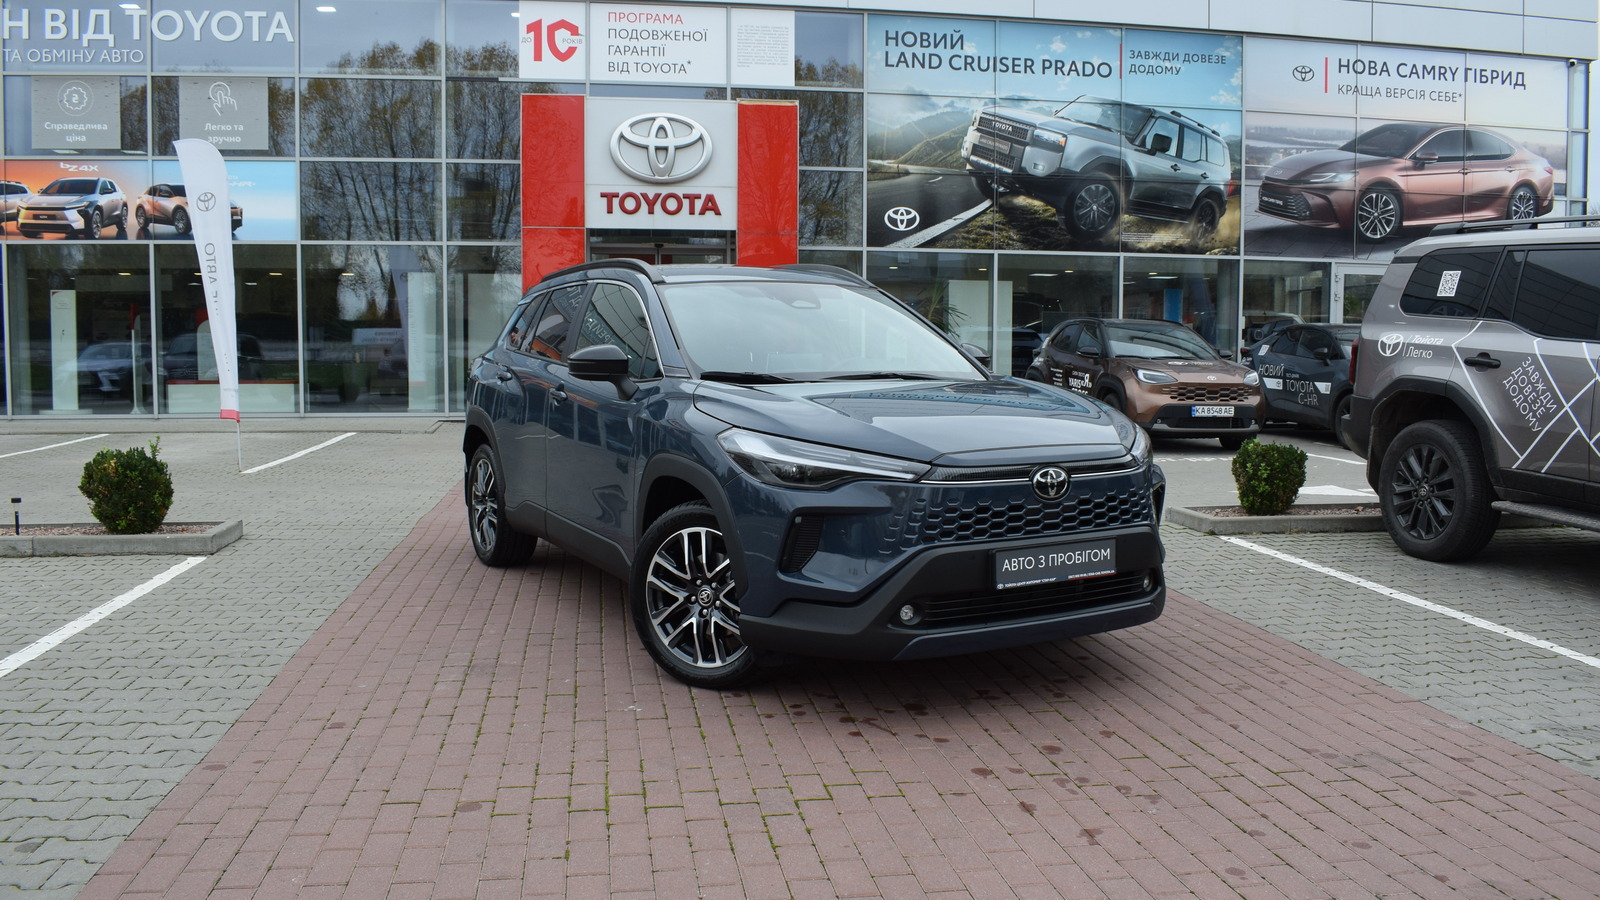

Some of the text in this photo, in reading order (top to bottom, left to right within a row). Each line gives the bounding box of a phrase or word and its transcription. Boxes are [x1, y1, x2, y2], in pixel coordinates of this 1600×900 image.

[607, 11, 684, 25] ПРОГРАМА
[44, 8, 115, 48] ВІД
[125, 9, 295, 43] TOYOTA
[607, 28, 709, 42] ПОДОВЖЕНОЇ
[561, 37, 583, 45] РОКІВ
[884, 29, 964, 51] НОВИЙ
[4, 48, 144, 64] ТА ОБМІНУ АВТО
[607, 43, 666, 57] ГАРАНТІЇ
[1129, 49, 1227, 65] ЗАВЖДИ ДОВЕЗЕ
[607, 61, 630, 75] ВІД
[884, 50, 1113, 79] LAND CRUISER PRADO
[1128, 63, 1182, 76] ДОДОМУ
[1338, 57, 1526, 91] НОВА CAMRY ГІБРИД
[1337, 83, 1382, 99] КРАЩА
[1385, 87, 1426, 101] ВЕРСІЯ
[44, 121, 108, 132] Справедлива
[204, 122, 244, 132] Легко та
[991, 121, 1013, 132] TOYOTA
[66, 133, 87, 144] ціна
[207, 134, 242, 145] зручно
[600, 191, 722, 216] TOYOTA
[1411, 334, 1444, 345] Тойота
[1405, 346, 1433, 359] Легко
[1258, 363, 1284, 377] НОВИЙ
[1286, 379, 1315, 393] TOYOTA
[1522, 356, 1558, 413] ЗАВЖДИ
[1298, 393, 1319, 406] C-HR
[1510, 366, 1546, 419] ДОВЕЗЕ
[1196, 407, 1205, 415] KA
[1224, 407, 1233, 415] AE
[1502, 378, 1543, 433] ДОДОМУ
[1002, 556, 1035, 572] АВТО
[1048, 547, 1111, 567] ПРОБІГОМ
